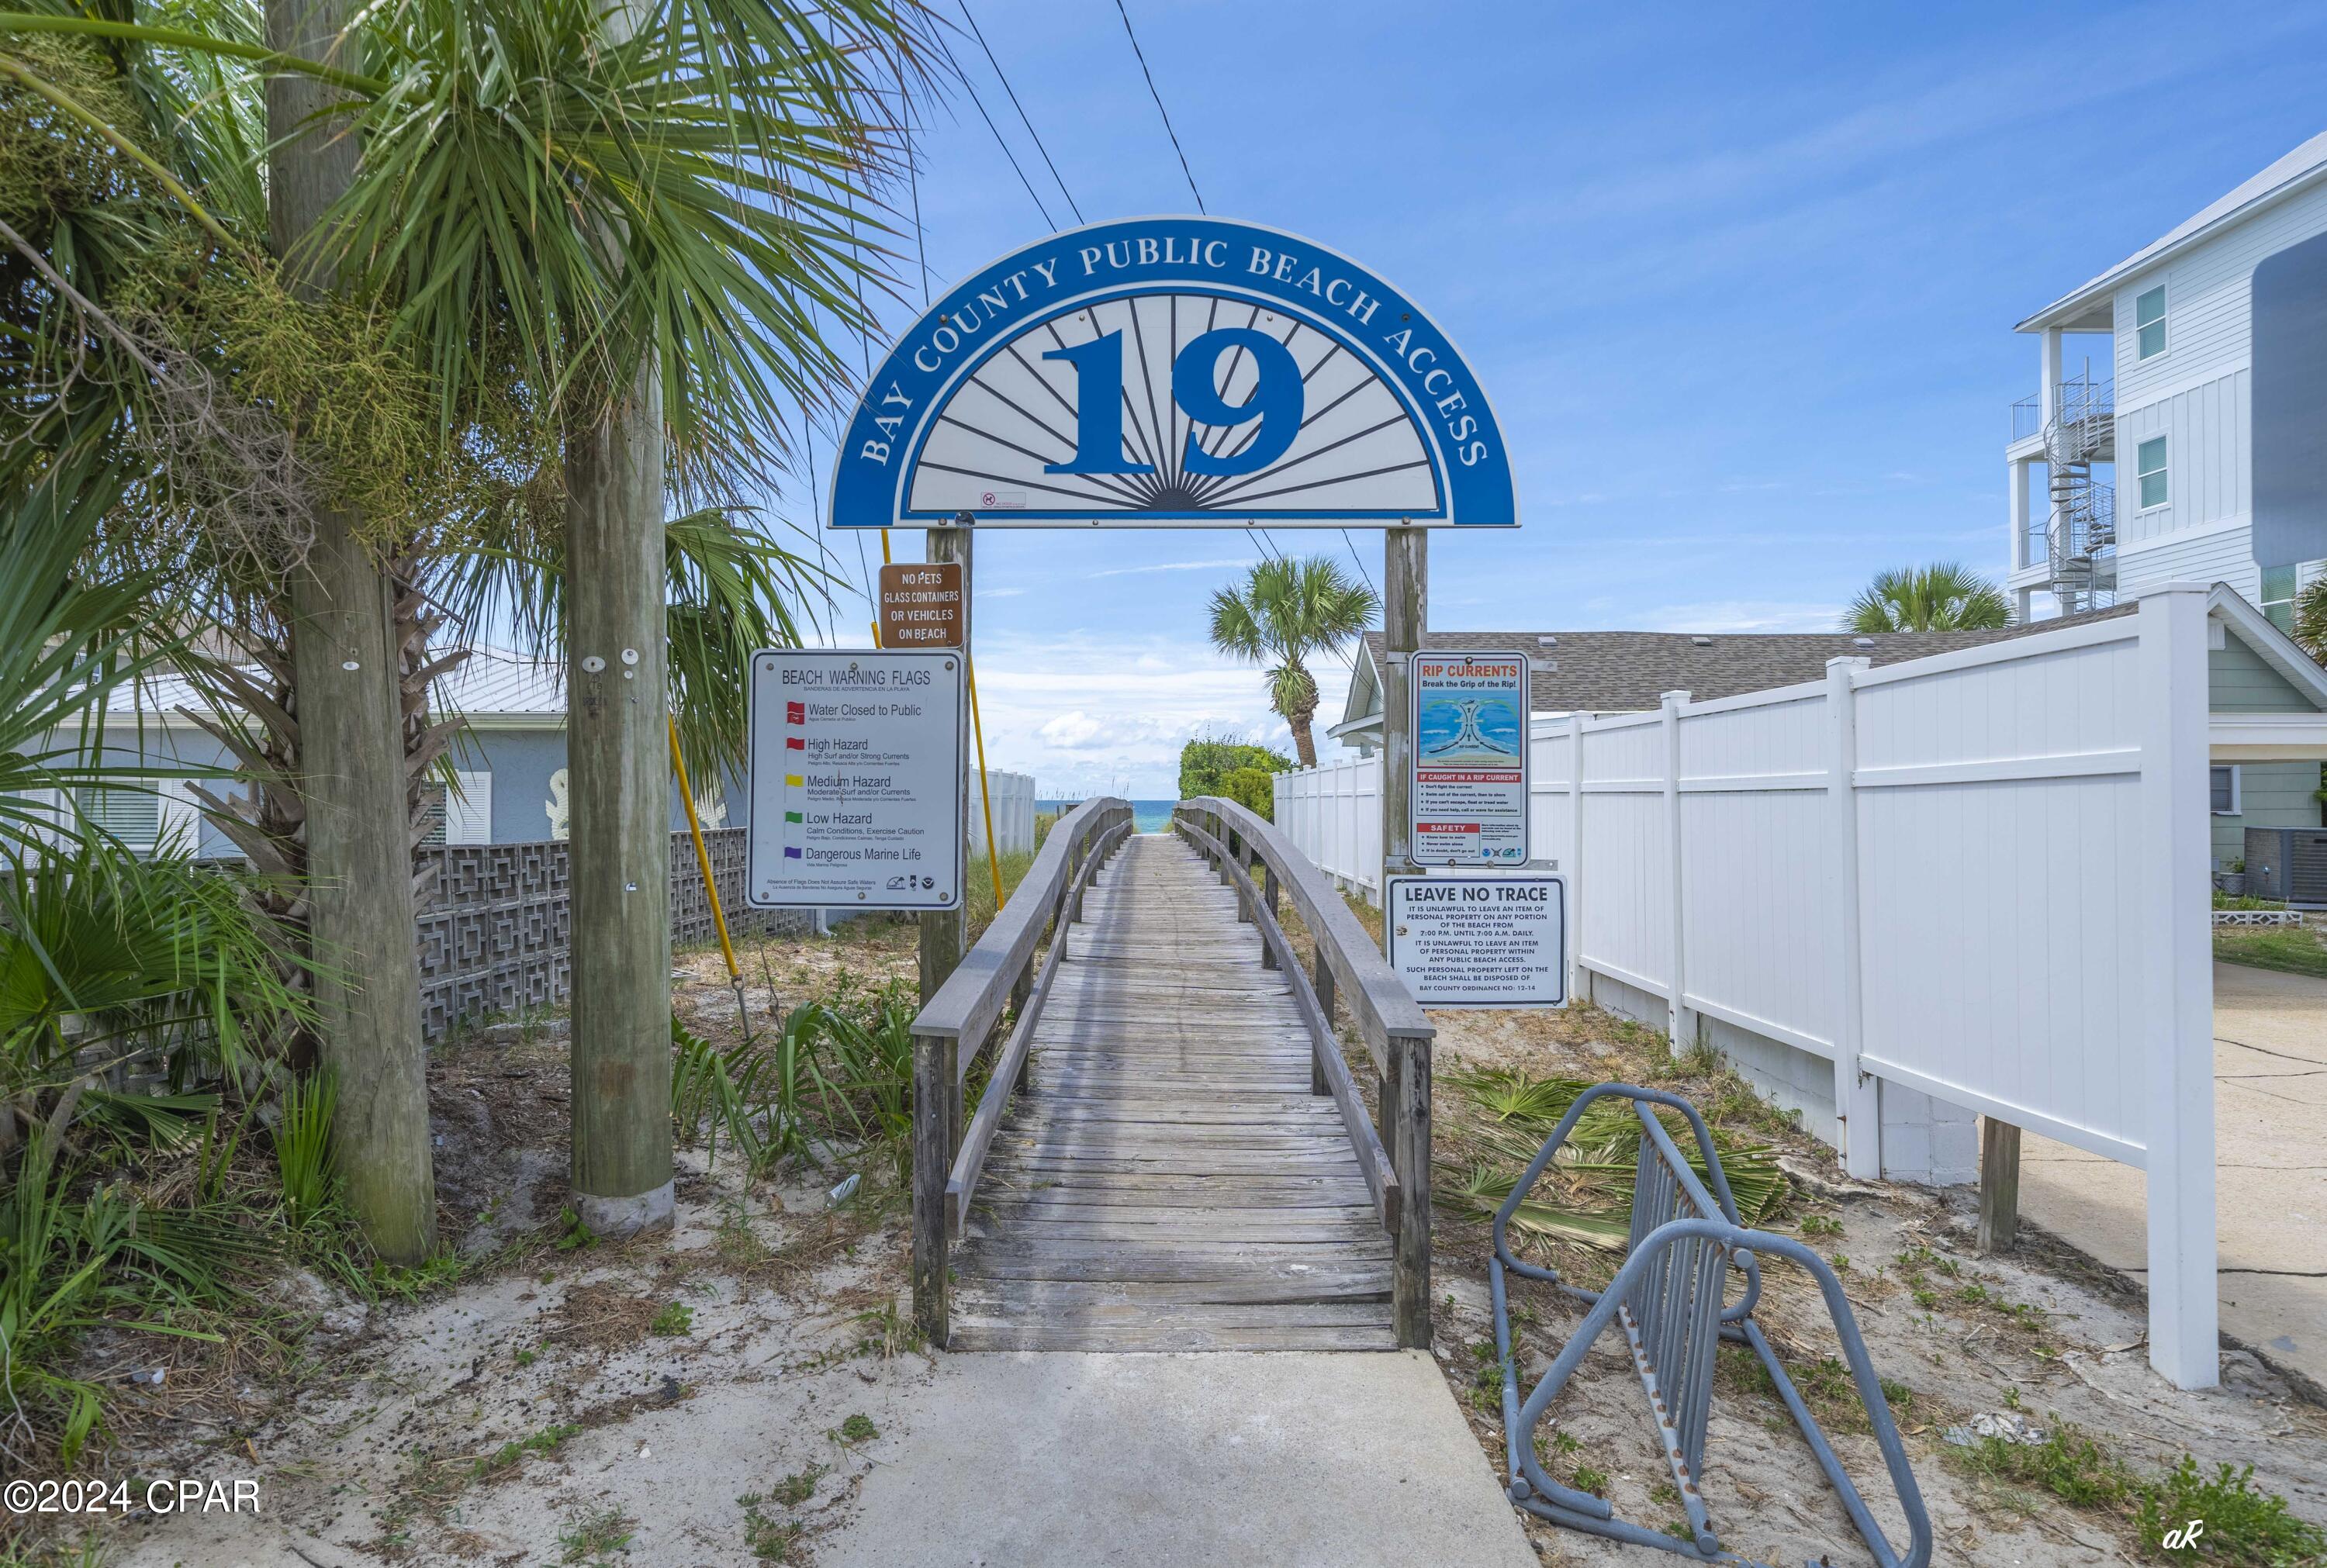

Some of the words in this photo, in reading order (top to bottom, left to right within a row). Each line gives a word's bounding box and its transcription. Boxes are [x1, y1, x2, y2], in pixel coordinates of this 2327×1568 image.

[861, 380, 914, 466] BAY
[915, 257, 1060, 373] COUNTY
[1077, 237, 1229, 276] PUBLIC
[1246, 247, 1381, 326] BEACH
[1383, 328, 1488, 467] ACCESS
[1042, 327, 1305, 476] 19
[902, 574, 916, 584] NO
[918, 573, 941, 584] PETS
[884, 592, 910, 603] GLASS
[912, 591, 958, 602] CONTAINERS
[891, 611, 904, 622] OR
[907, 609, 953, 621] VEHICLES
[899, 629, 912, 639] ON
[915, 628, 946, 639] BEACH
[1423, 665, 1443, 676] RIP
[1448, 665, 1517, 677] CURRENTS
[782, 670, 822, 685] BEACH
[829, 670, 885, 685] WARNING
[892, 670, 930, 685] FLAGS
[1460, 680, 1476, 689] Grip
[1501, 680, 1516, 689] Rip!
[809, 704, 838, 716] Water
[841, 704, 875, 716] Closed
[878, 705, 888, 716] to
[891, 704, 921, 716] Public
[808, 738, 830, 753] High
[833, 738, 868, 750] Hazard
[860, 753, 881, 761] Strong
[808, 775, 849, 787] Medium
[853, 776, 891, 787] Hazard
[807, 812, 829, 824] Low
[833, 812, 872, 824] Hazard
[806, 848, 861, 863] Dangerous
[865, 848, 899, 860] Marine
[903, 848, 921, 860] Life
[1406, 887, 1456, 901] LEAVE
[1462, 887, 1490, 901] NO
[1495, 887, 1547, 901] TRACE
